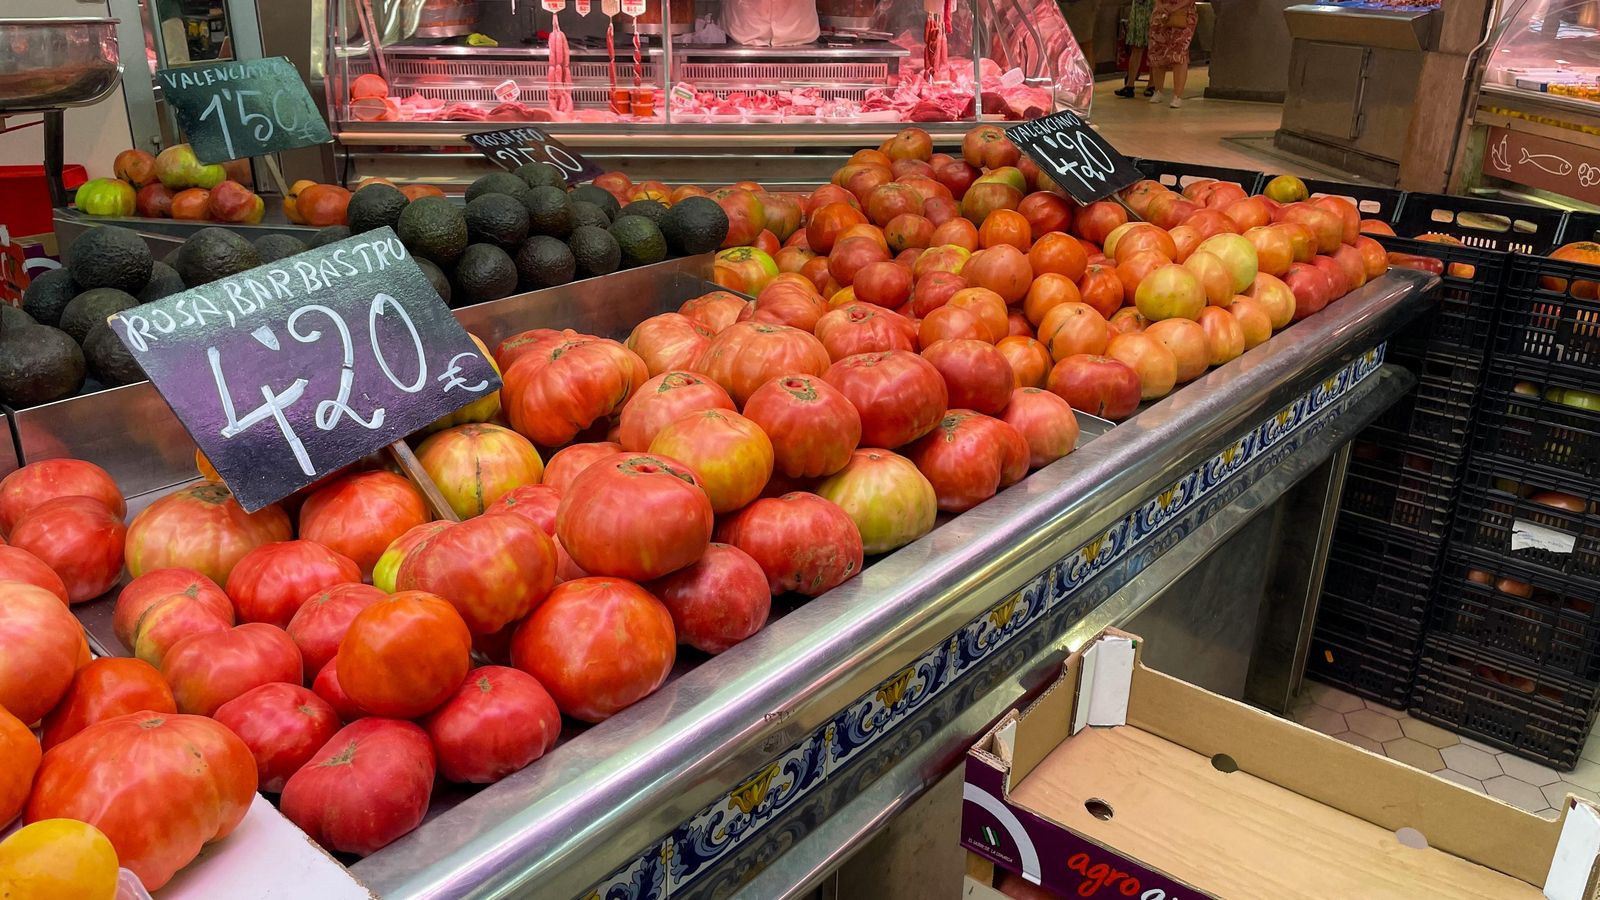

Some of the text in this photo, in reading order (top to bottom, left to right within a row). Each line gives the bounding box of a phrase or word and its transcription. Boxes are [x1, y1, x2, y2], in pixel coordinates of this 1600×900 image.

[1008, 112, 1081, 143] VALENCIANO
[1032, 130, 1115, 192] 4'20
[207, 292, 489, 476] 4'20 €
